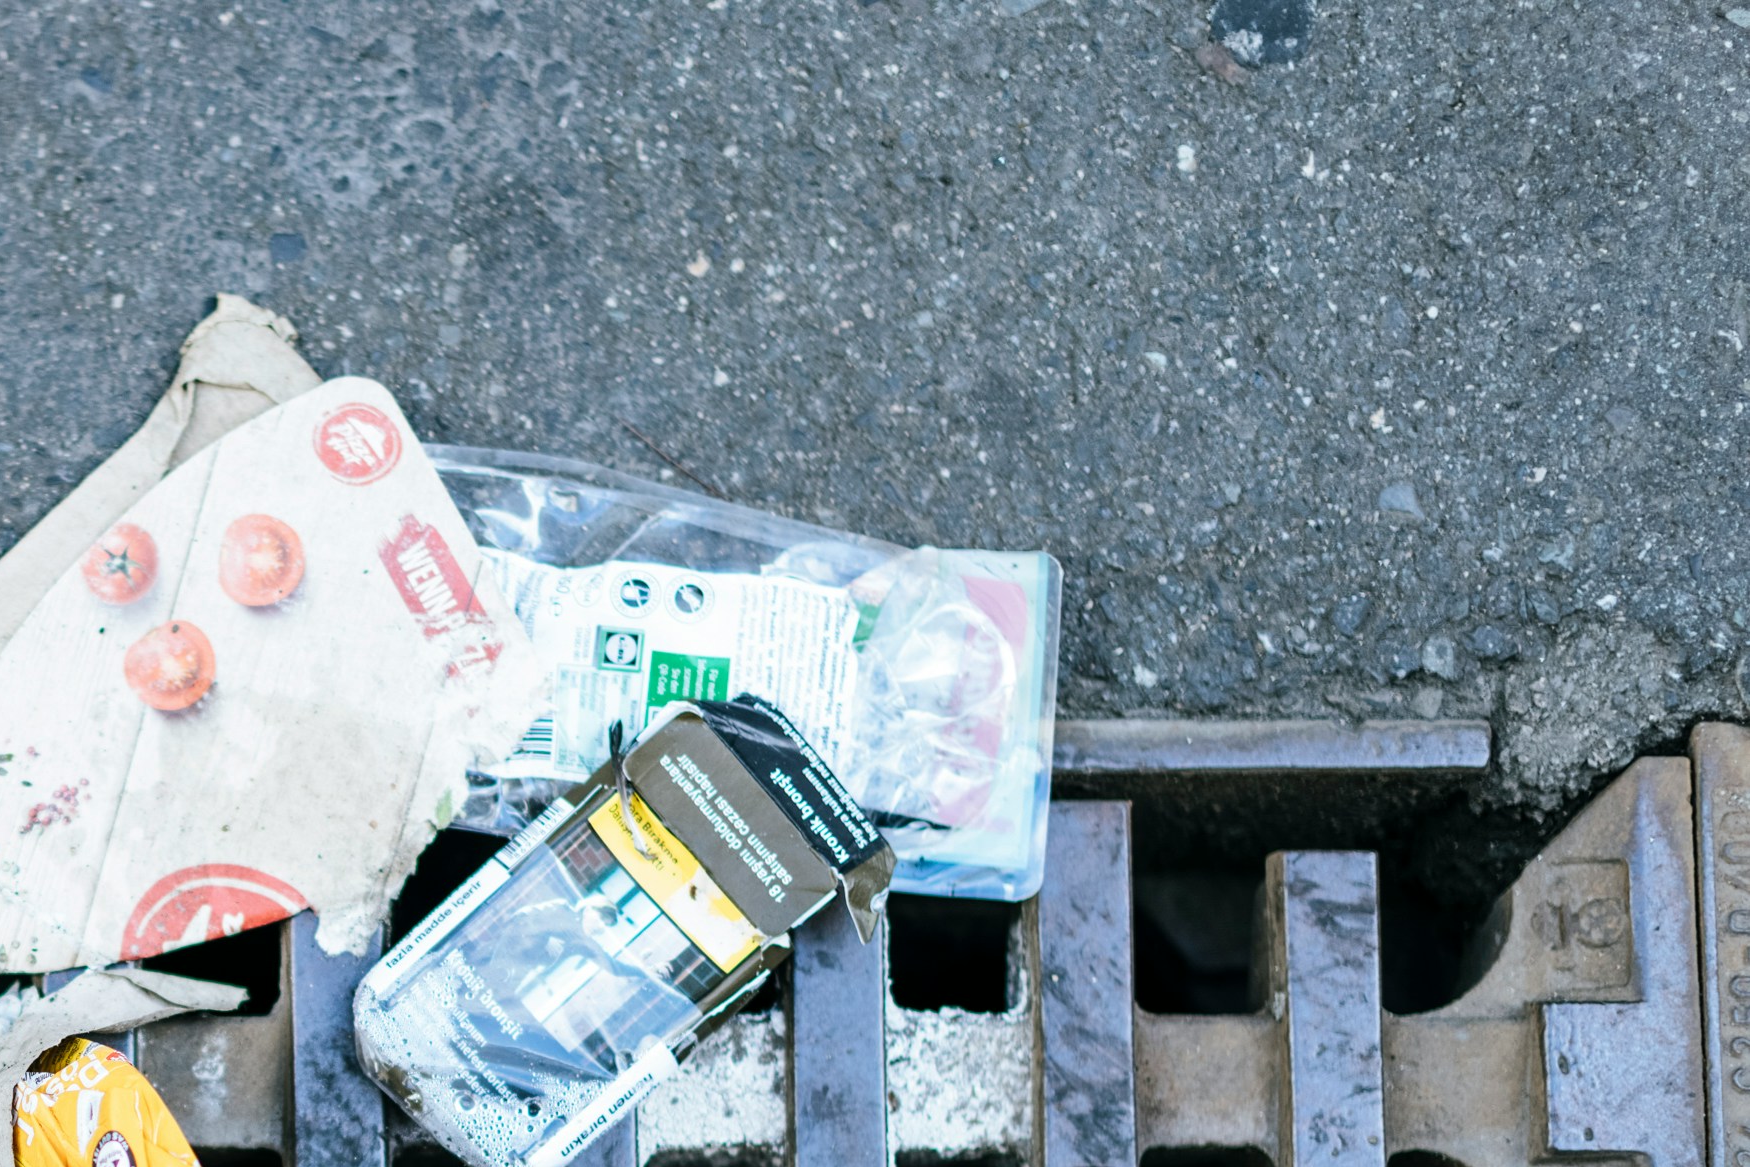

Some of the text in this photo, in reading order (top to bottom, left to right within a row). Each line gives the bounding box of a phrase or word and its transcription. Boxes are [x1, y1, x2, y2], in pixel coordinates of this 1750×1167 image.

[393, 538, 459, 620] WENN
[799, 744, 832, 780] nefesi
[657, 752, 788, 904] 18 yaşını doldurmayanlara
[674, 749, 795, 888] satışının cezası hapistir
[766, 766, 851, 864] Kronik bronşit
[800, 766, 870, 848] Sigara kullanımı
[858, 819, 880, 841] her
[384, 877, 483, 970] fazla madde içerir
[559, 1113, 606, 1158] bırakın
